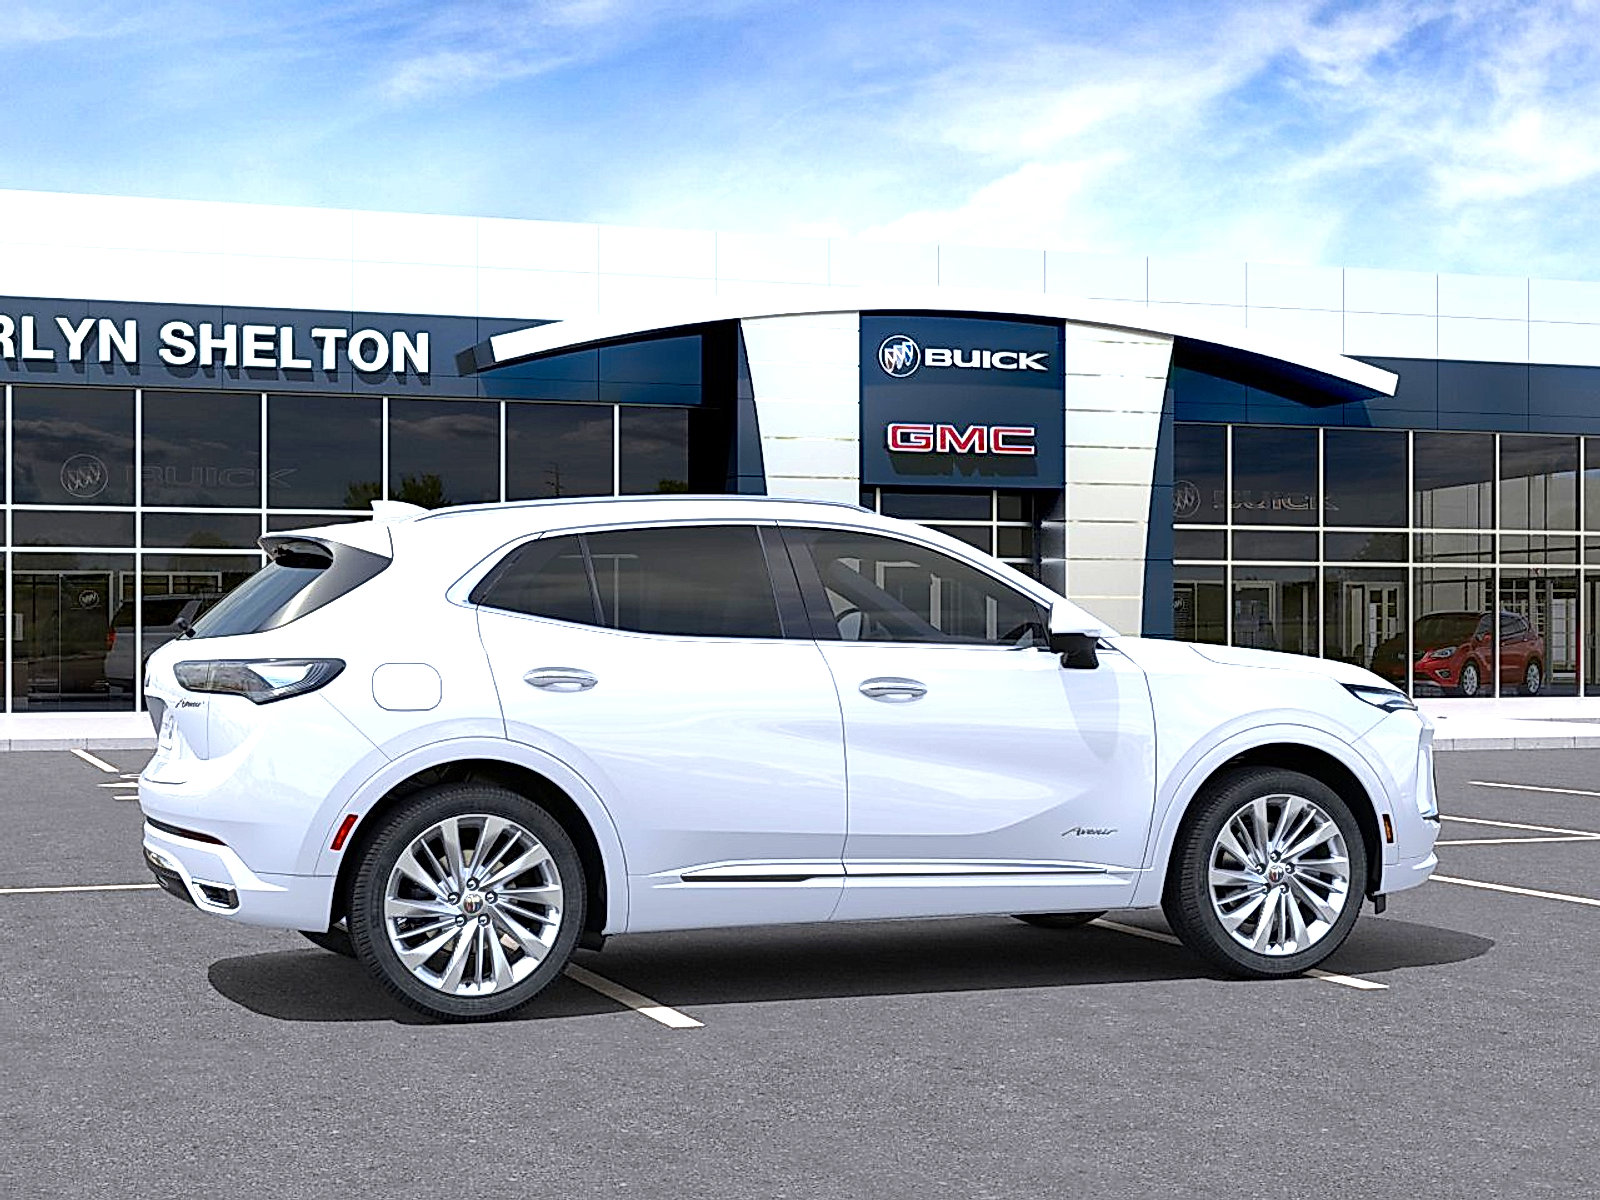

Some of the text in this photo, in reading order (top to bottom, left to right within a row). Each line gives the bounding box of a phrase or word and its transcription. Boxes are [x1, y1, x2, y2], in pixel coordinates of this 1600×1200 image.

[158, 320, 429, 374] SHELTON
[924, 347, 1050, 371] BUICK
[887, 423, 1035, 455] GMC
